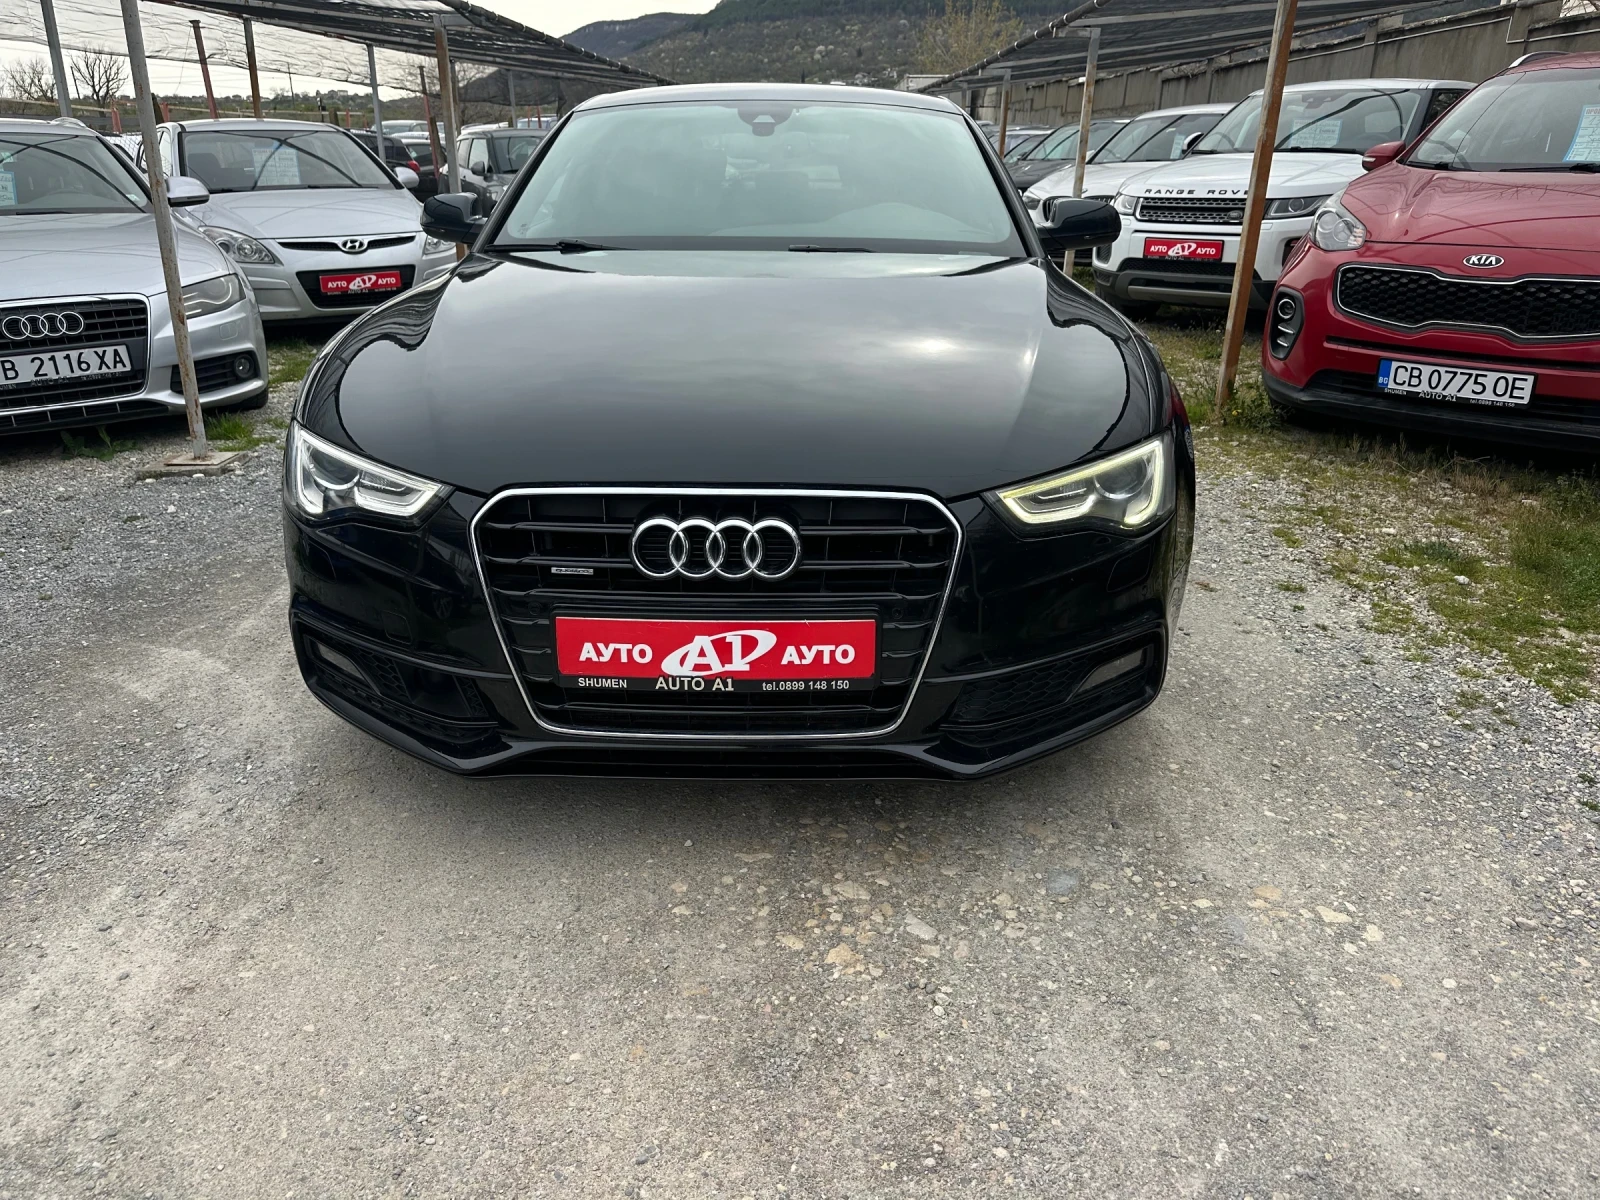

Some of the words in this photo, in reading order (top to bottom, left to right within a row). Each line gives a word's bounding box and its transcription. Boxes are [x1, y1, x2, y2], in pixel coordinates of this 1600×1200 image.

[1150, 245, 1167, 253] АУТО
[1196, 247, 1216, 255] АУТО
[1469, 255, 1496, 265] KIA
[378, 277, 396, 285] АУТО
[30, 352, 91, 378] 2116
[94, 348, 127, 371] XA
[1378, 376, 1388, 384] BG
[1393, 365, 1423, 388] CB
[1428, 369, 1488, 395] 0775
[1418, 390, 1443, 400] AUTO
[1445, 393, 1457, 402] A1
[579, 642, 653, 664] АУТО
[780, 644, 856, 665] АУТО
[578, 677, 627, 688] SHUMEN
[655, 676, 705, 691] AUTO
[712, 677, 734, 691] A1
[762, 681, 805, 691] tel.0899
[808, 681, 828, 690] 148
[831, 680, 850, 689] 150
